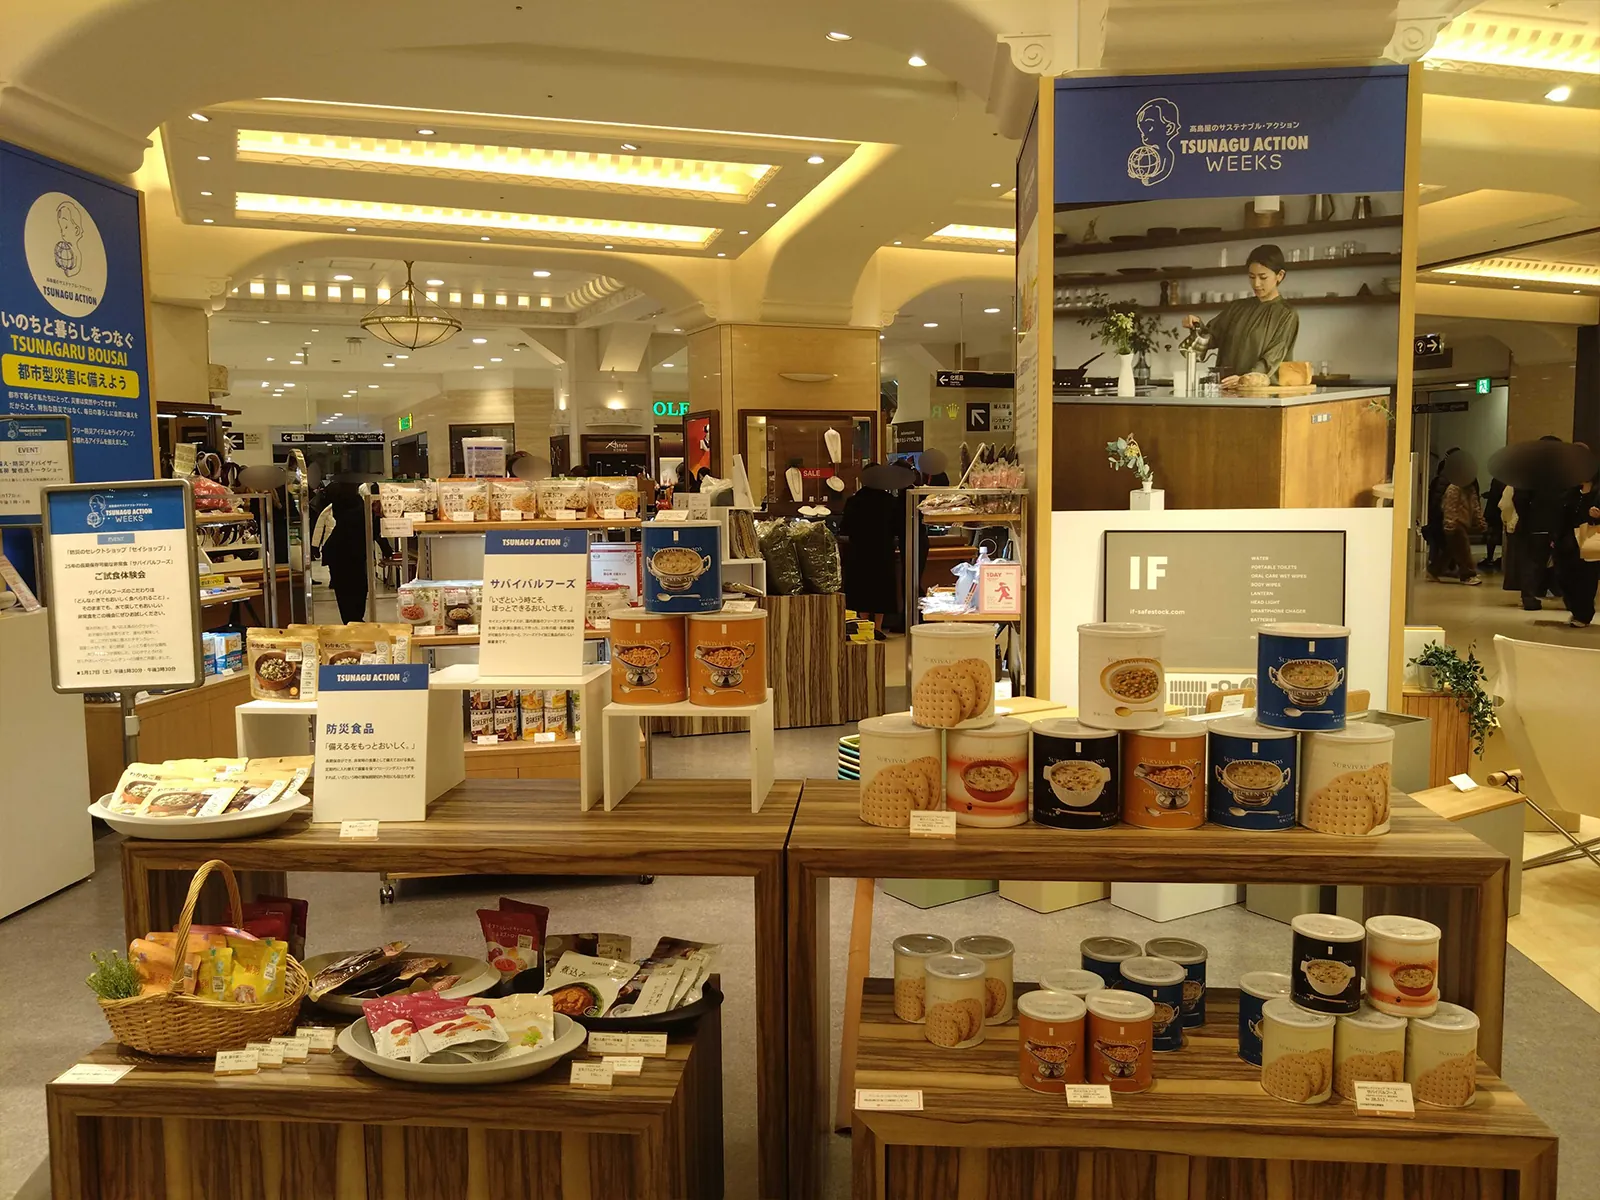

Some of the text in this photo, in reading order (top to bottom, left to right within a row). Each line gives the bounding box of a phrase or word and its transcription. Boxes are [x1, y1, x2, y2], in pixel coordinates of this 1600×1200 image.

[1189, 121, 1300, 133] 高島屋のサステナブル・アクション
[1180, 135, 1308, 154] TSUNAGU ACTION
[1206, 154, 1282, 172] WEEKS
[43, 286, 97, 306] TSUNAGU ACTION
[1, 311, 135, 349] いのちと暮らしをつなぐ
[10, 335, 128, 366] TSUNAGARU BOUSAI
[18, 362, 127, 390] 都市型災害に備えよう
[105, 507, 153, 516] TSUNAGU ACTION
[115, 514, 144, 523] WEEKS
[502, 538, 561, 546] TSUNAGU ACTION
[94, 570, 146, 581] ご試食体験会
[1129, 556, 1168, 590] IF
[490, 579, 576, 589] サバイバルフーズ
[489, 596, 546, 604] 「いざという時こそ、
[491, 604, 573, 613] ほっとできるおいしさを。」
[337, 673, 400, 682] TSUNAGU ACTION
[472, 717, 489, 727] BAKERY
[496, 716, 512, 725] BAKERY
[326, 723, 374, 735] 防災食品
[325, 742, 416, 750] 「備えるをもっとおいしく。」
[1332, 761, 1368, 770] SURVIVAL
[130, 771, 162, 781] わかめご飯
